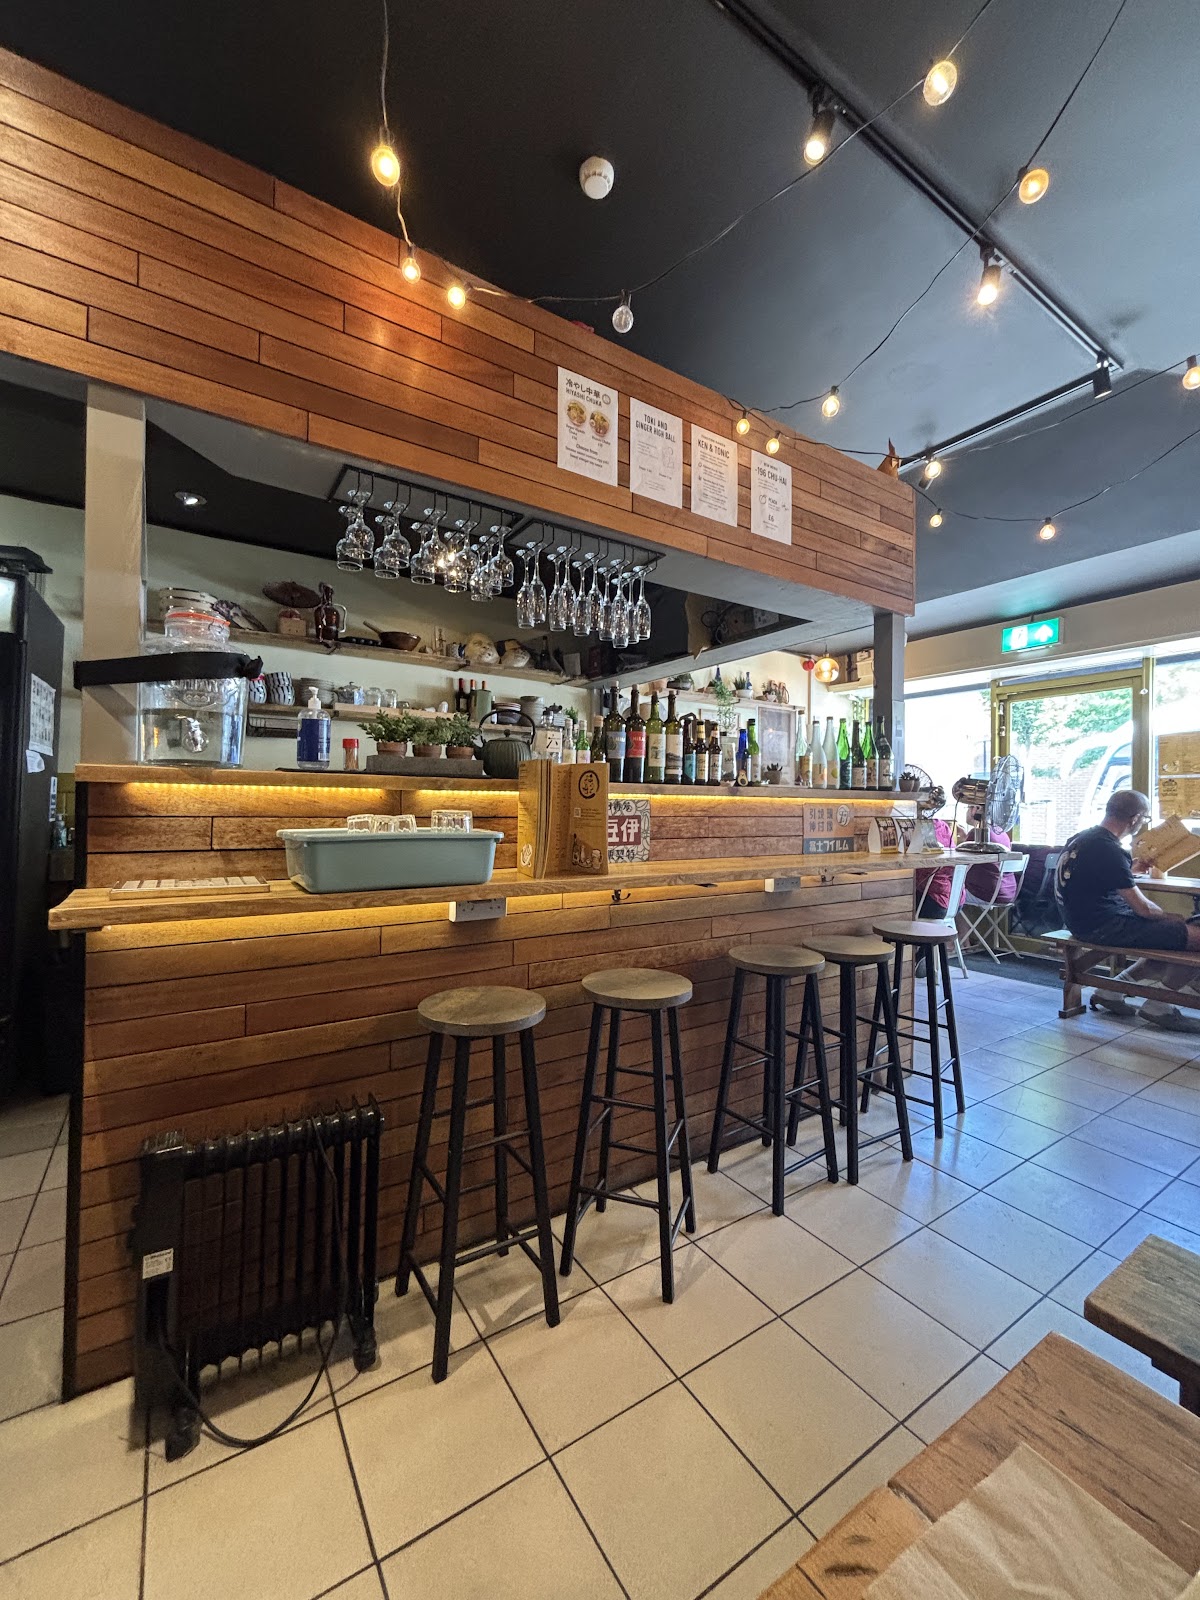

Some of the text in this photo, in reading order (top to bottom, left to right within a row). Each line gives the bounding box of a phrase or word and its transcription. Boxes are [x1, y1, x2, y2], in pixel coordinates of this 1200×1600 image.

[566, 378, 600, 399] 冷やし中華
[566, 387, 602, 407] HIYASHI CHUKA
[636, 420, 676, 443] GINGER HIGH BALL
[644, 414, 667, 431] TOKI AND
[698, 439, 708, 450] KEN
[709, 444, 713, 453] &
[715, 446, 729, 459] TONIC
[755, 466, 766, 477] -196
[809, 839, 849, 853] 富士フイルム
